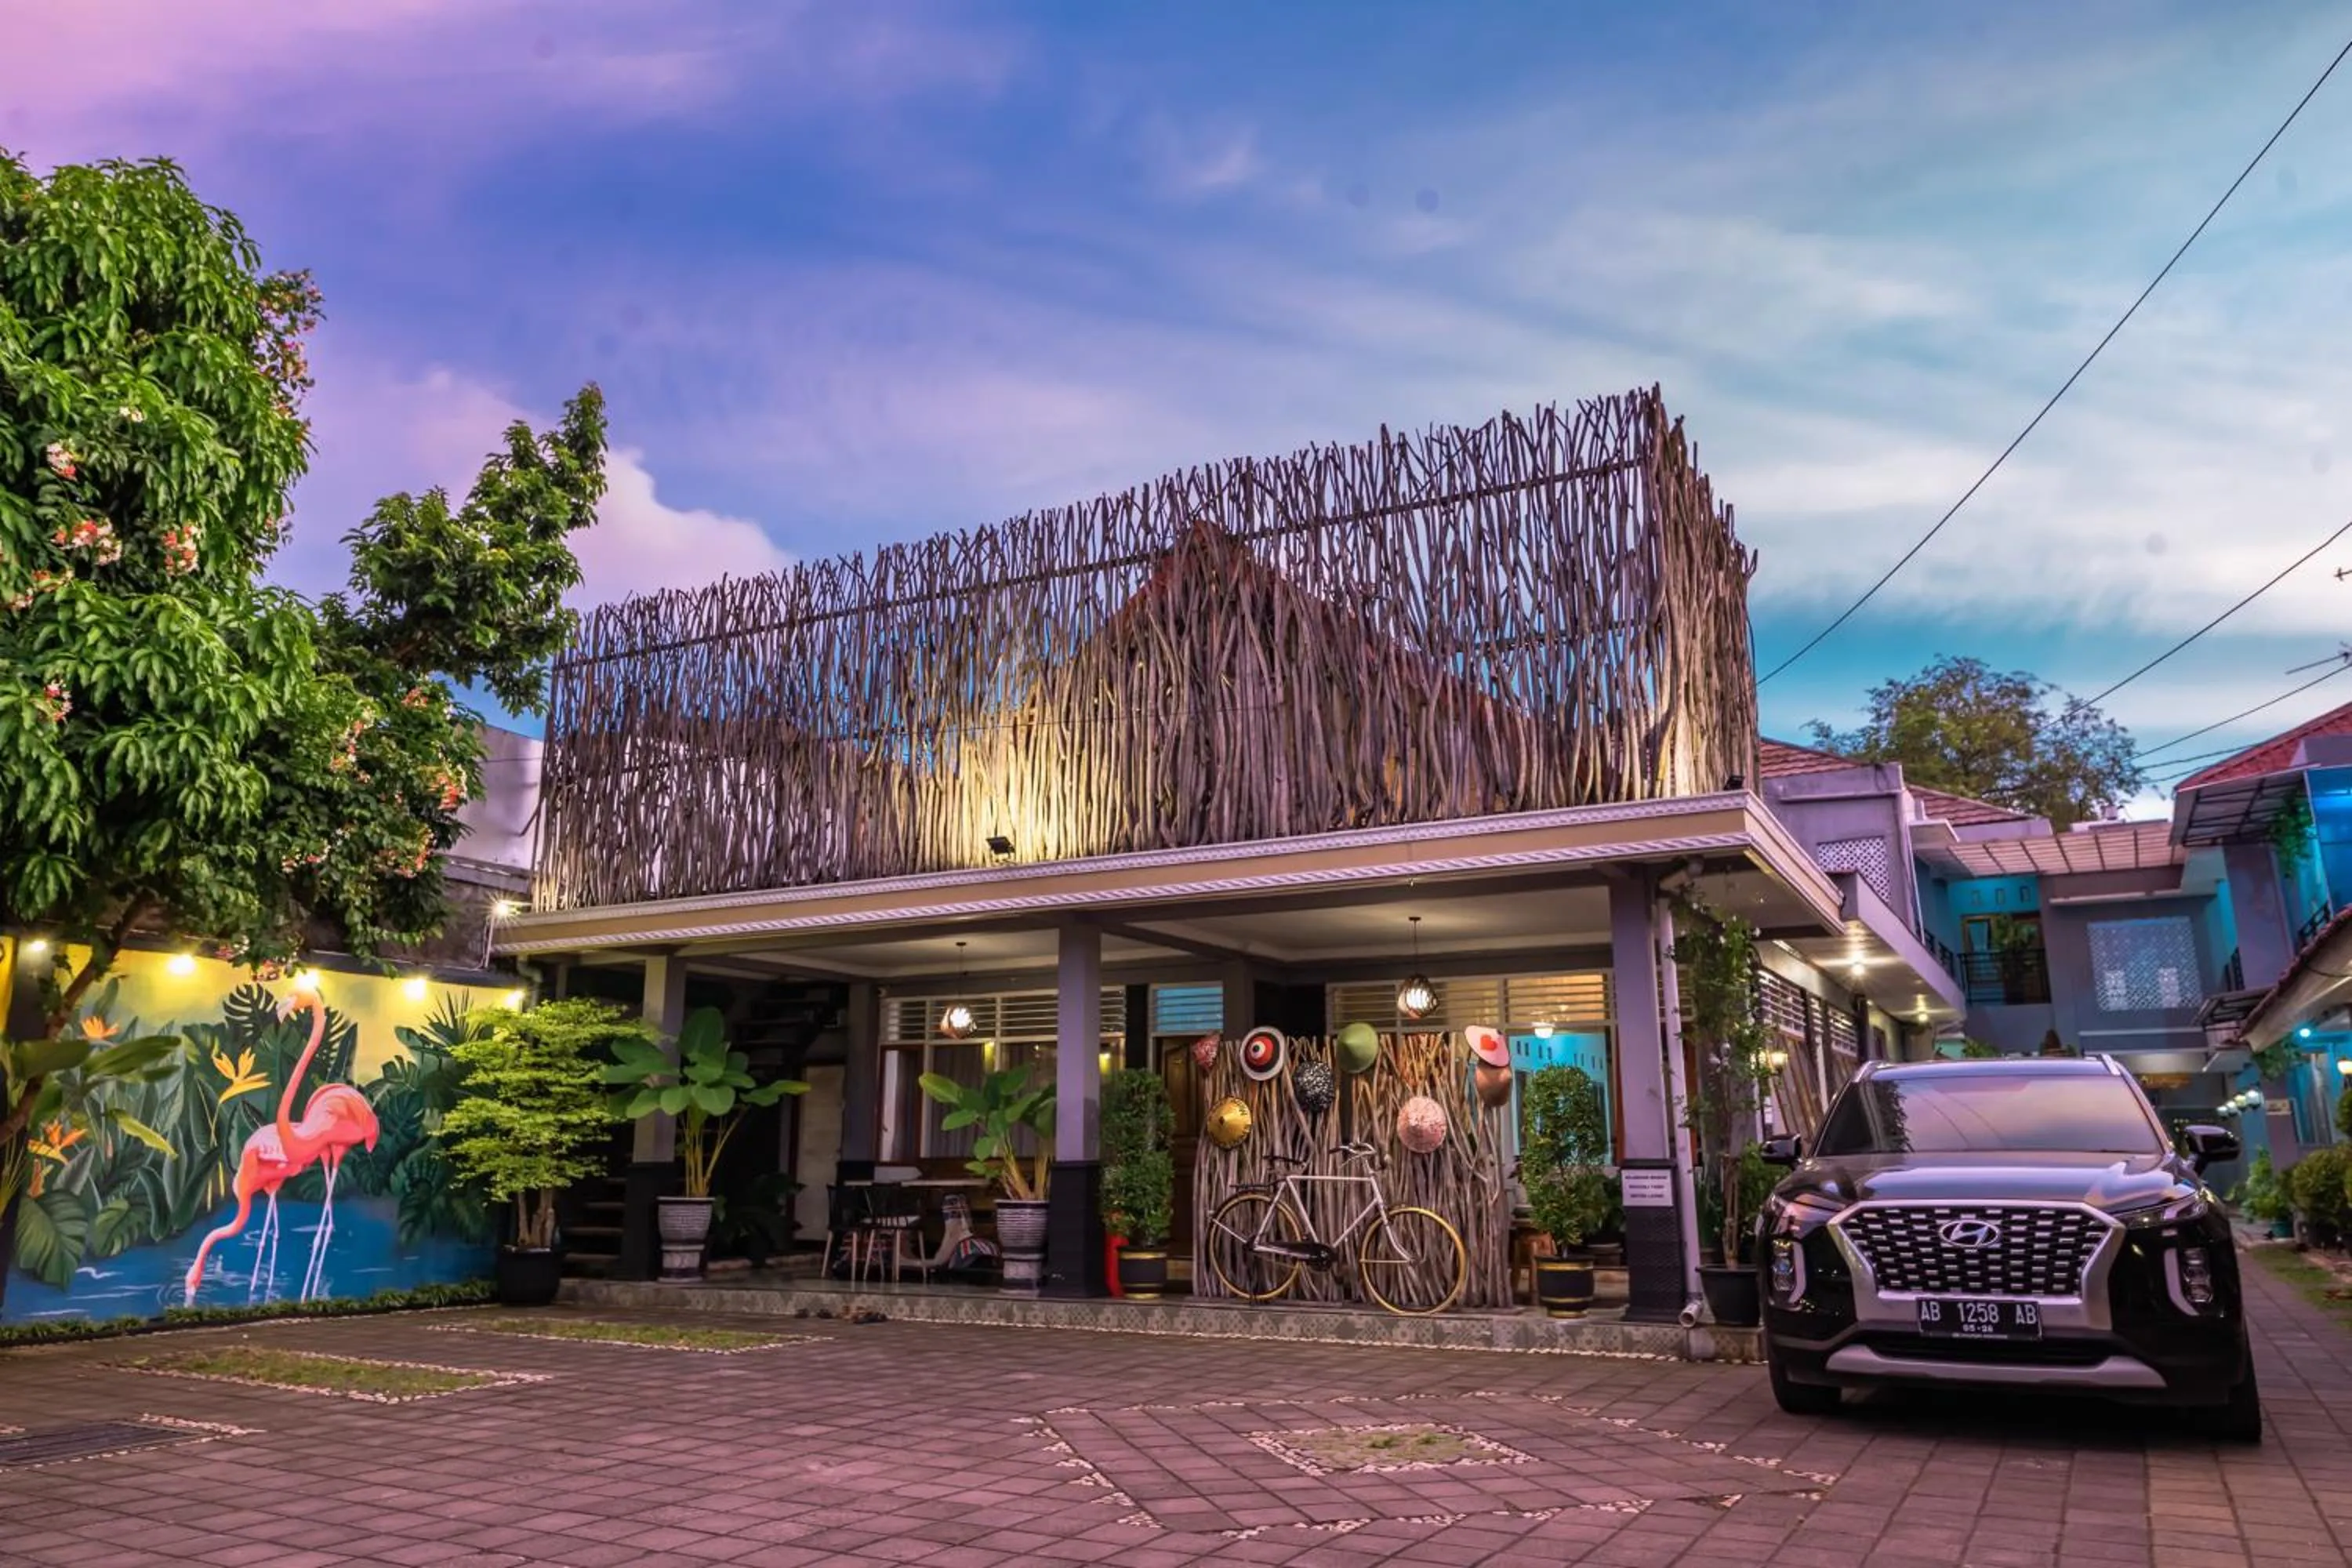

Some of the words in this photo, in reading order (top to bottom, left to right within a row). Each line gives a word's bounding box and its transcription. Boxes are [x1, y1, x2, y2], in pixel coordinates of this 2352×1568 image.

[1921, 1301, 1941, 1322] AB
[1957, 1302, 1999, 1323] 1258
[2015, 1304, 2037, 1325] AB
